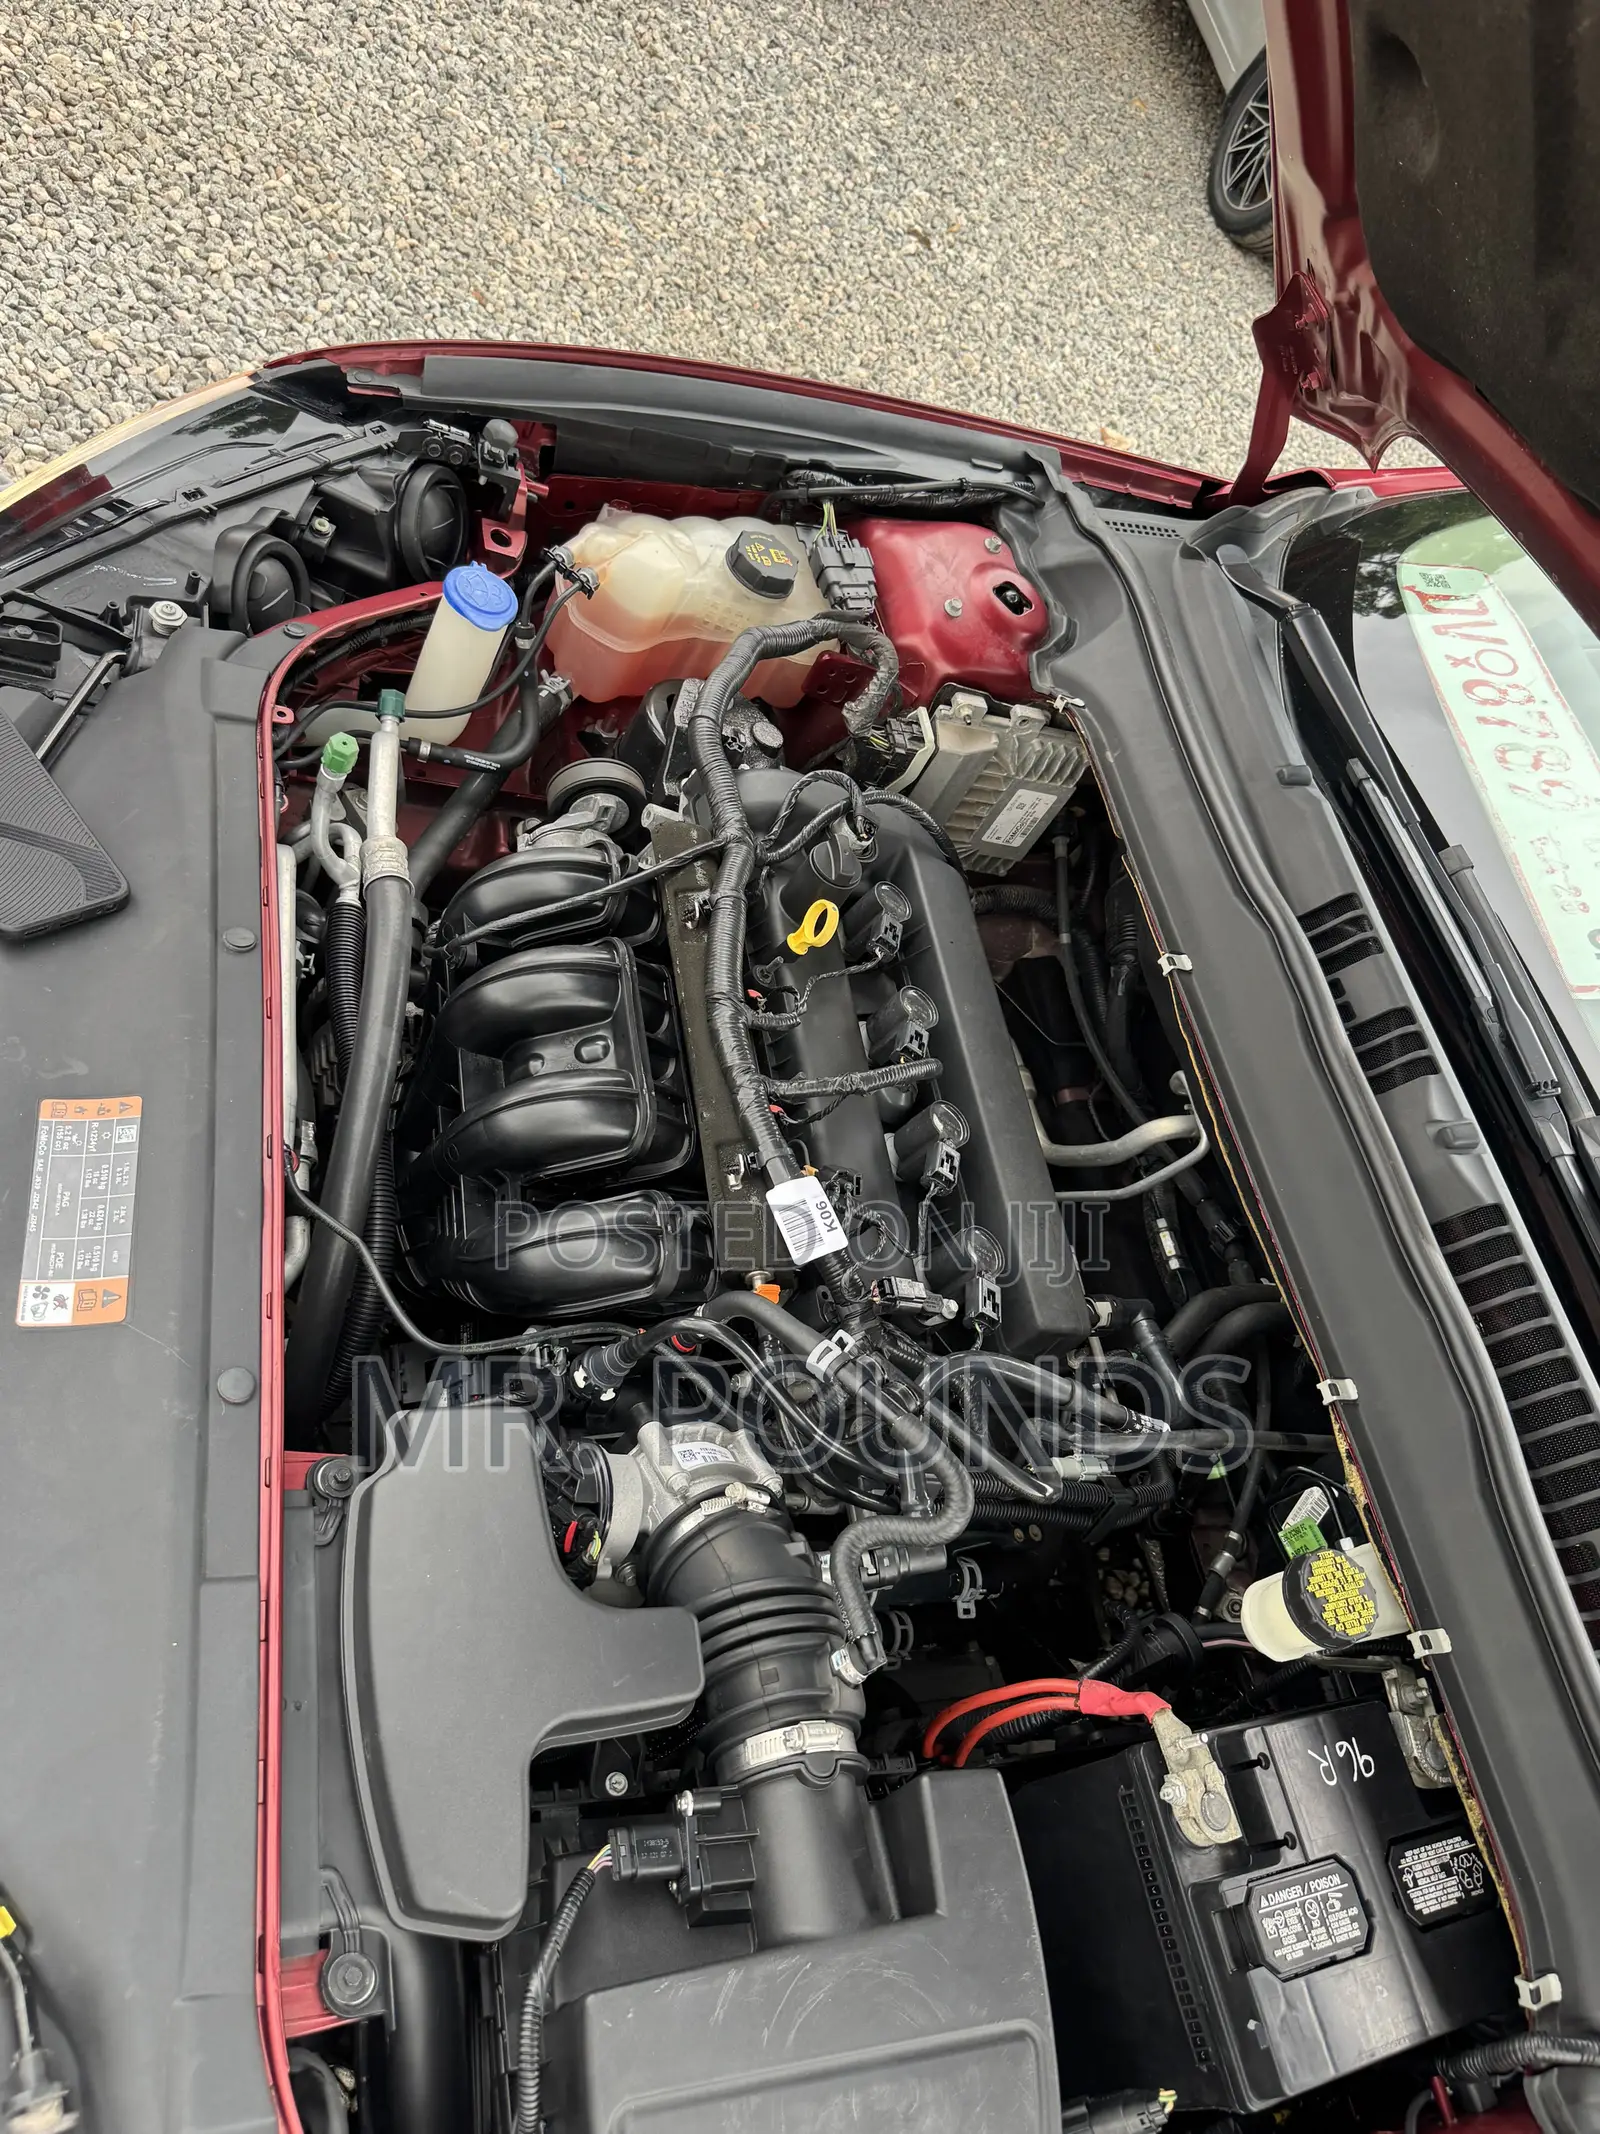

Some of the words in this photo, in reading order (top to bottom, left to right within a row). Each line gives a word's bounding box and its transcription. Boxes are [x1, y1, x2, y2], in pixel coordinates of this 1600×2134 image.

[38, 1125, 50, 1155] FoMoCo
[62, 1191, 70, 1208] PAG
[816, 1200, 838, 1233] K06
[55, 1252, 65, 1269] POE
[1307, 1736, 1376, 1786] 96R
[1267, 1884, 1303, 1905] DANGER
[1308, 1873, 1341, 1892] POISON
